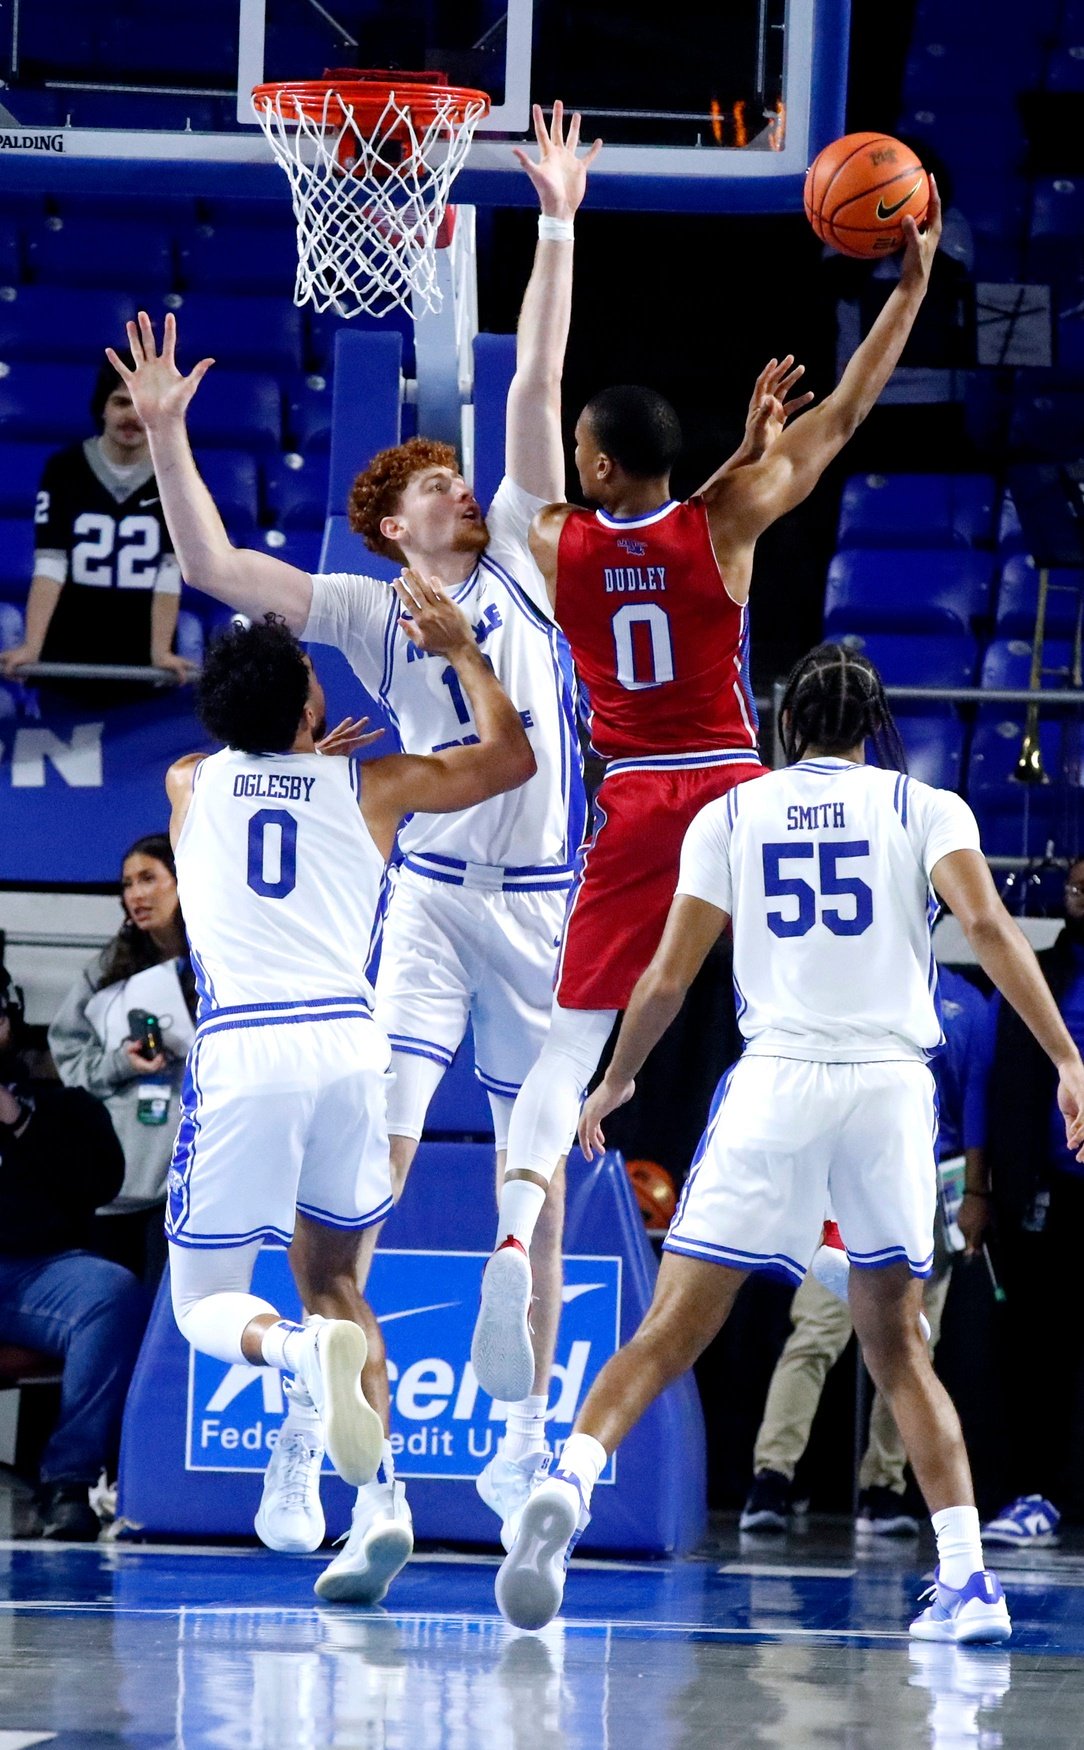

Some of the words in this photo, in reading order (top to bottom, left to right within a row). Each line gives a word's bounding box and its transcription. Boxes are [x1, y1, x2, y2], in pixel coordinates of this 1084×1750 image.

[71, 512, 161, 589] 22
[604, 567, 666, 593] DUDLEY
[611, 602, 676, 691] 0
[0, 721, 104, 788] N
[233, 774, 316, 802] OGLESBY
[787, 802, 846, 831] SMITH
[246, 808, 298, 900] 0
[762, 840, 874, 938] 55
[201, 1420, 281, 1450] Fede
[388, 1427, 454, 1456] edit
